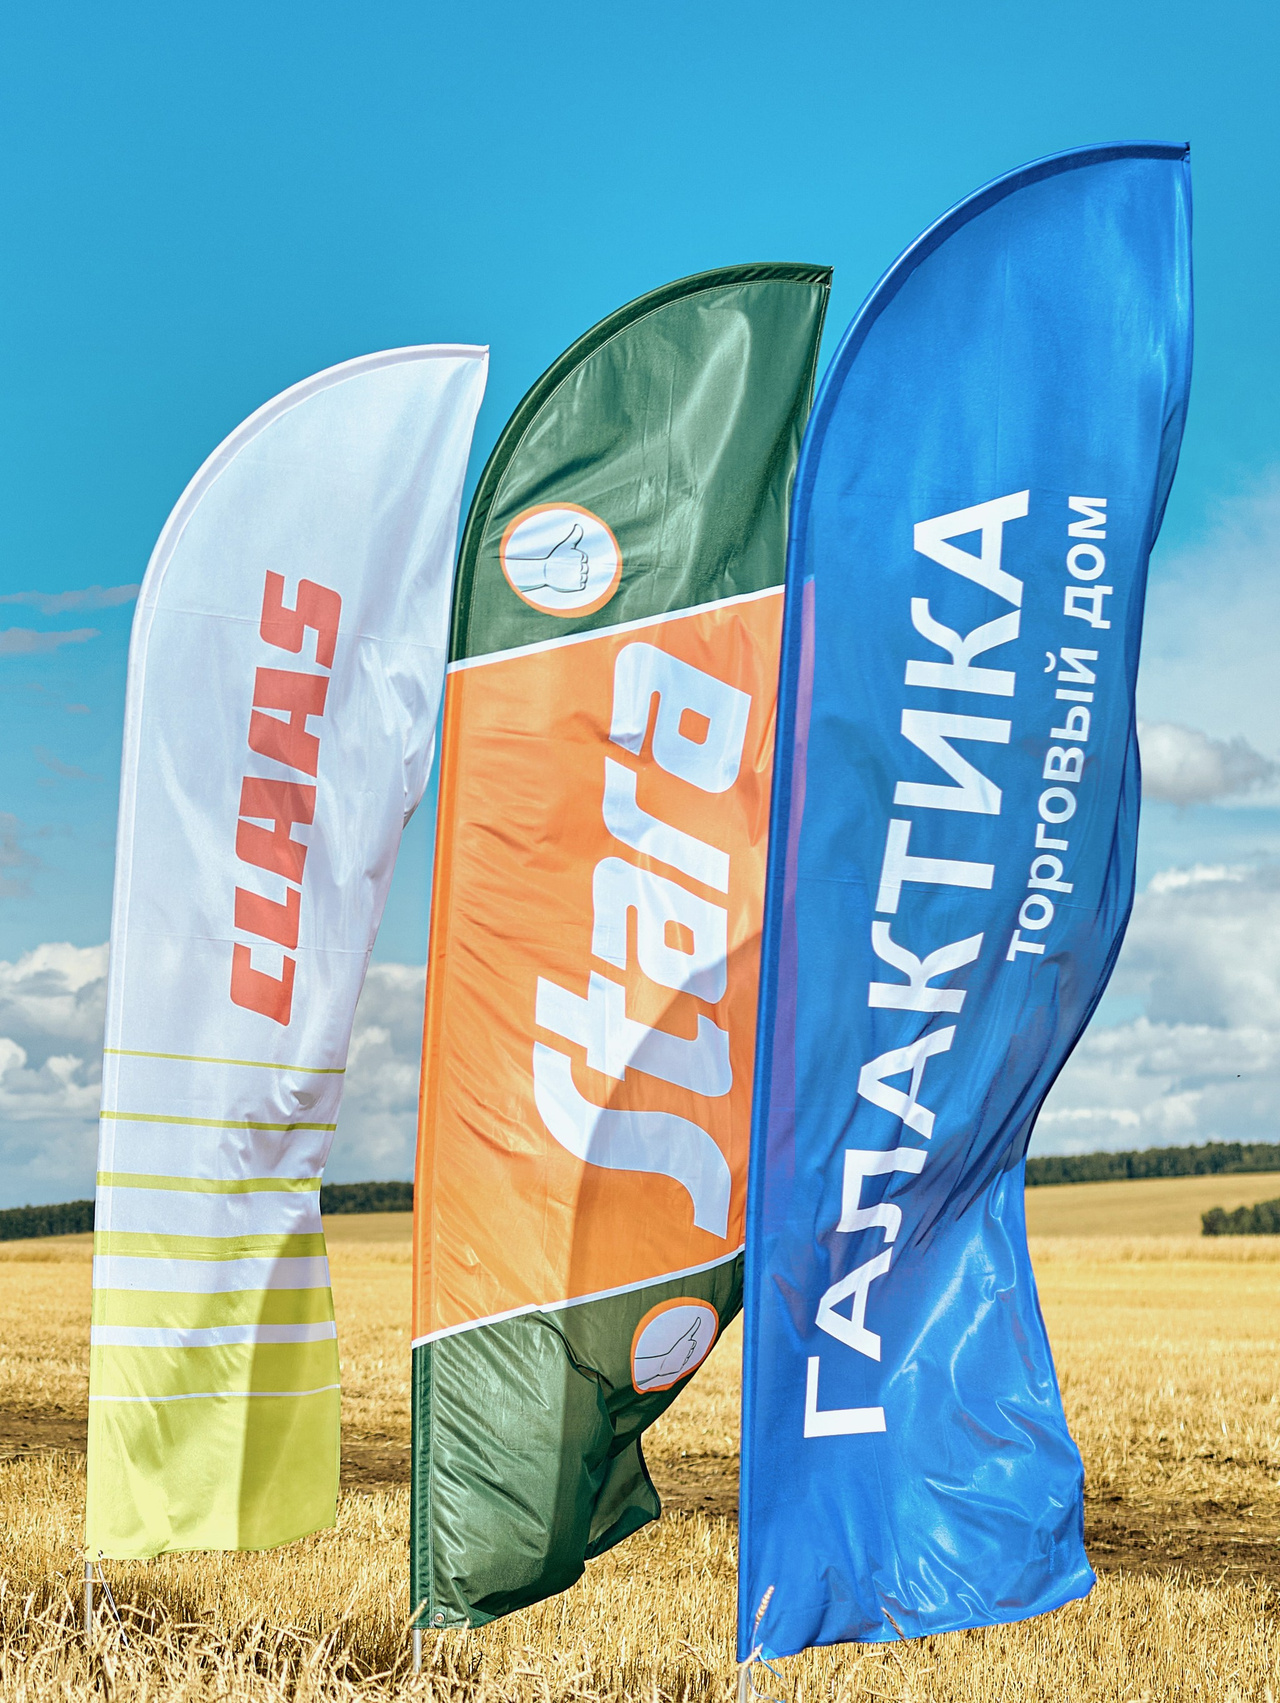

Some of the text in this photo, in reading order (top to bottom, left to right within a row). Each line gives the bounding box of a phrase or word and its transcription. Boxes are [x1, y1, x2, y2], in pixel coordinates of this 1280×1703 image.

[230, 570, 342, 1027] CLAAS
[533, 642, 752, 1239] Stara
[803, 489, 1030, 1439] ГАЛАКТИКА
[1005, 495, 1114, 962] торговый дом
